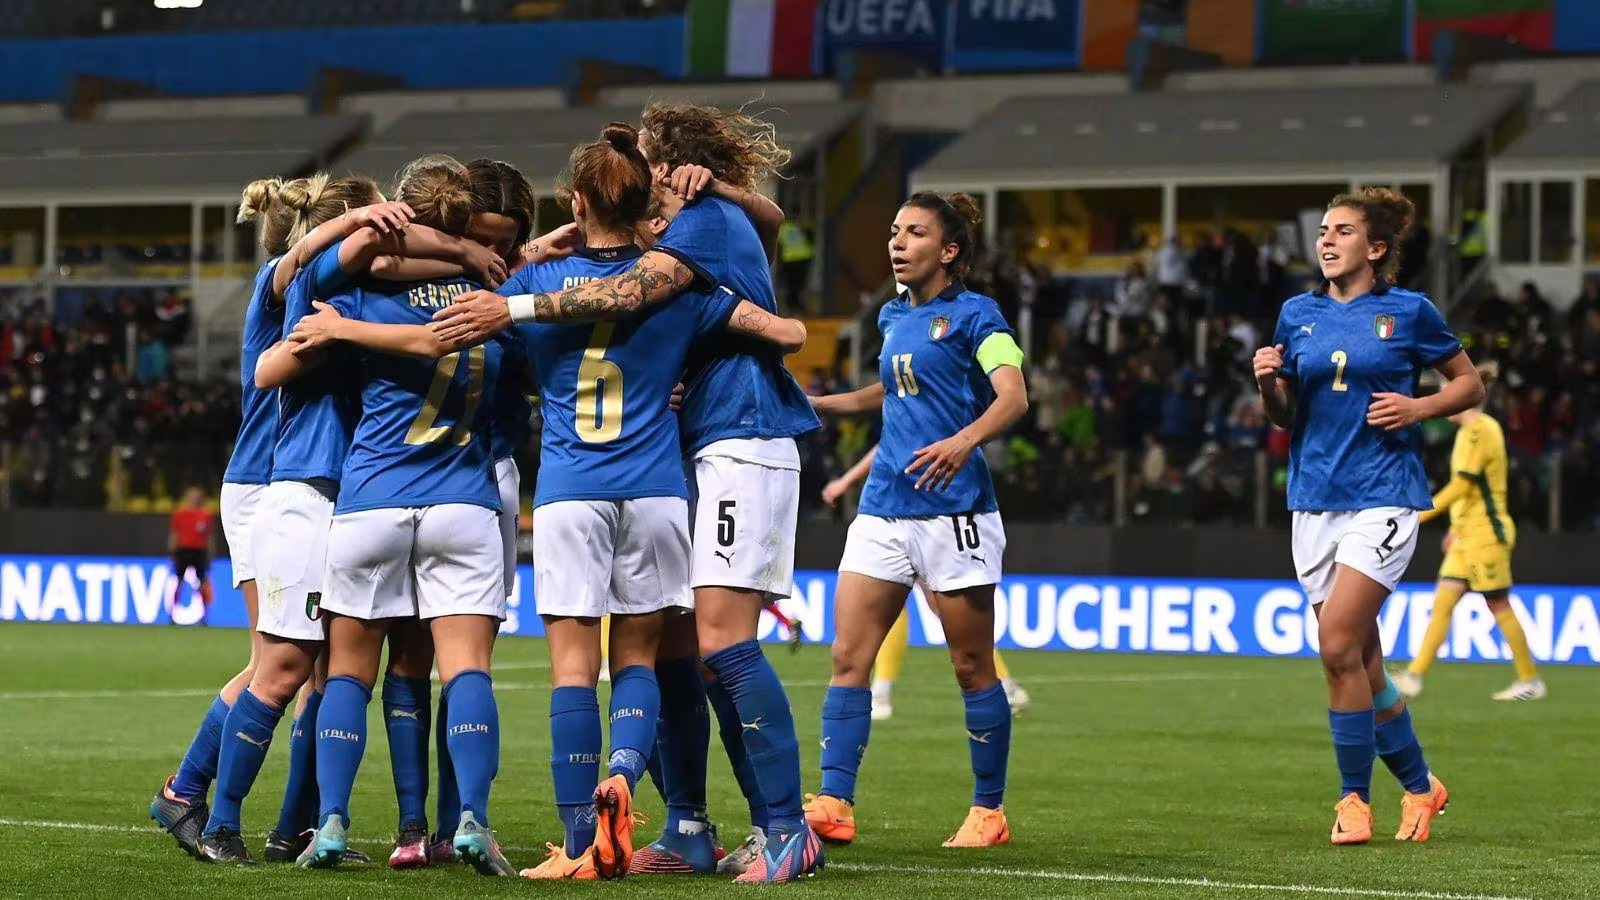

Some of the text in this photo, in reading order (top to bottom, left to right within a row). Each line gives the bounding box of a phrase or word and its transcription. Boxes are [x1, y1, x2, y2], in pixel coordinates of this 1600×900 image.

[827, 0, 936, 35] UEFA
[575, 321, 623, 443] 6
[892, 353, 919, 397] 13
[1331, 350, 1348, 391] 2
[404, 344, 485, 446] 21
[717, 500, 736, 547] 5
[951, 511, 980, 552] 13
[1380, 518, 1398, 552] 2
[912, 582, 1240, 653] VUCHER
[1253, 587, 1600, 663] GVERNA
[320, 728, 359, 741] ITALIA
[449, 723, 488, 736] ITALIA
